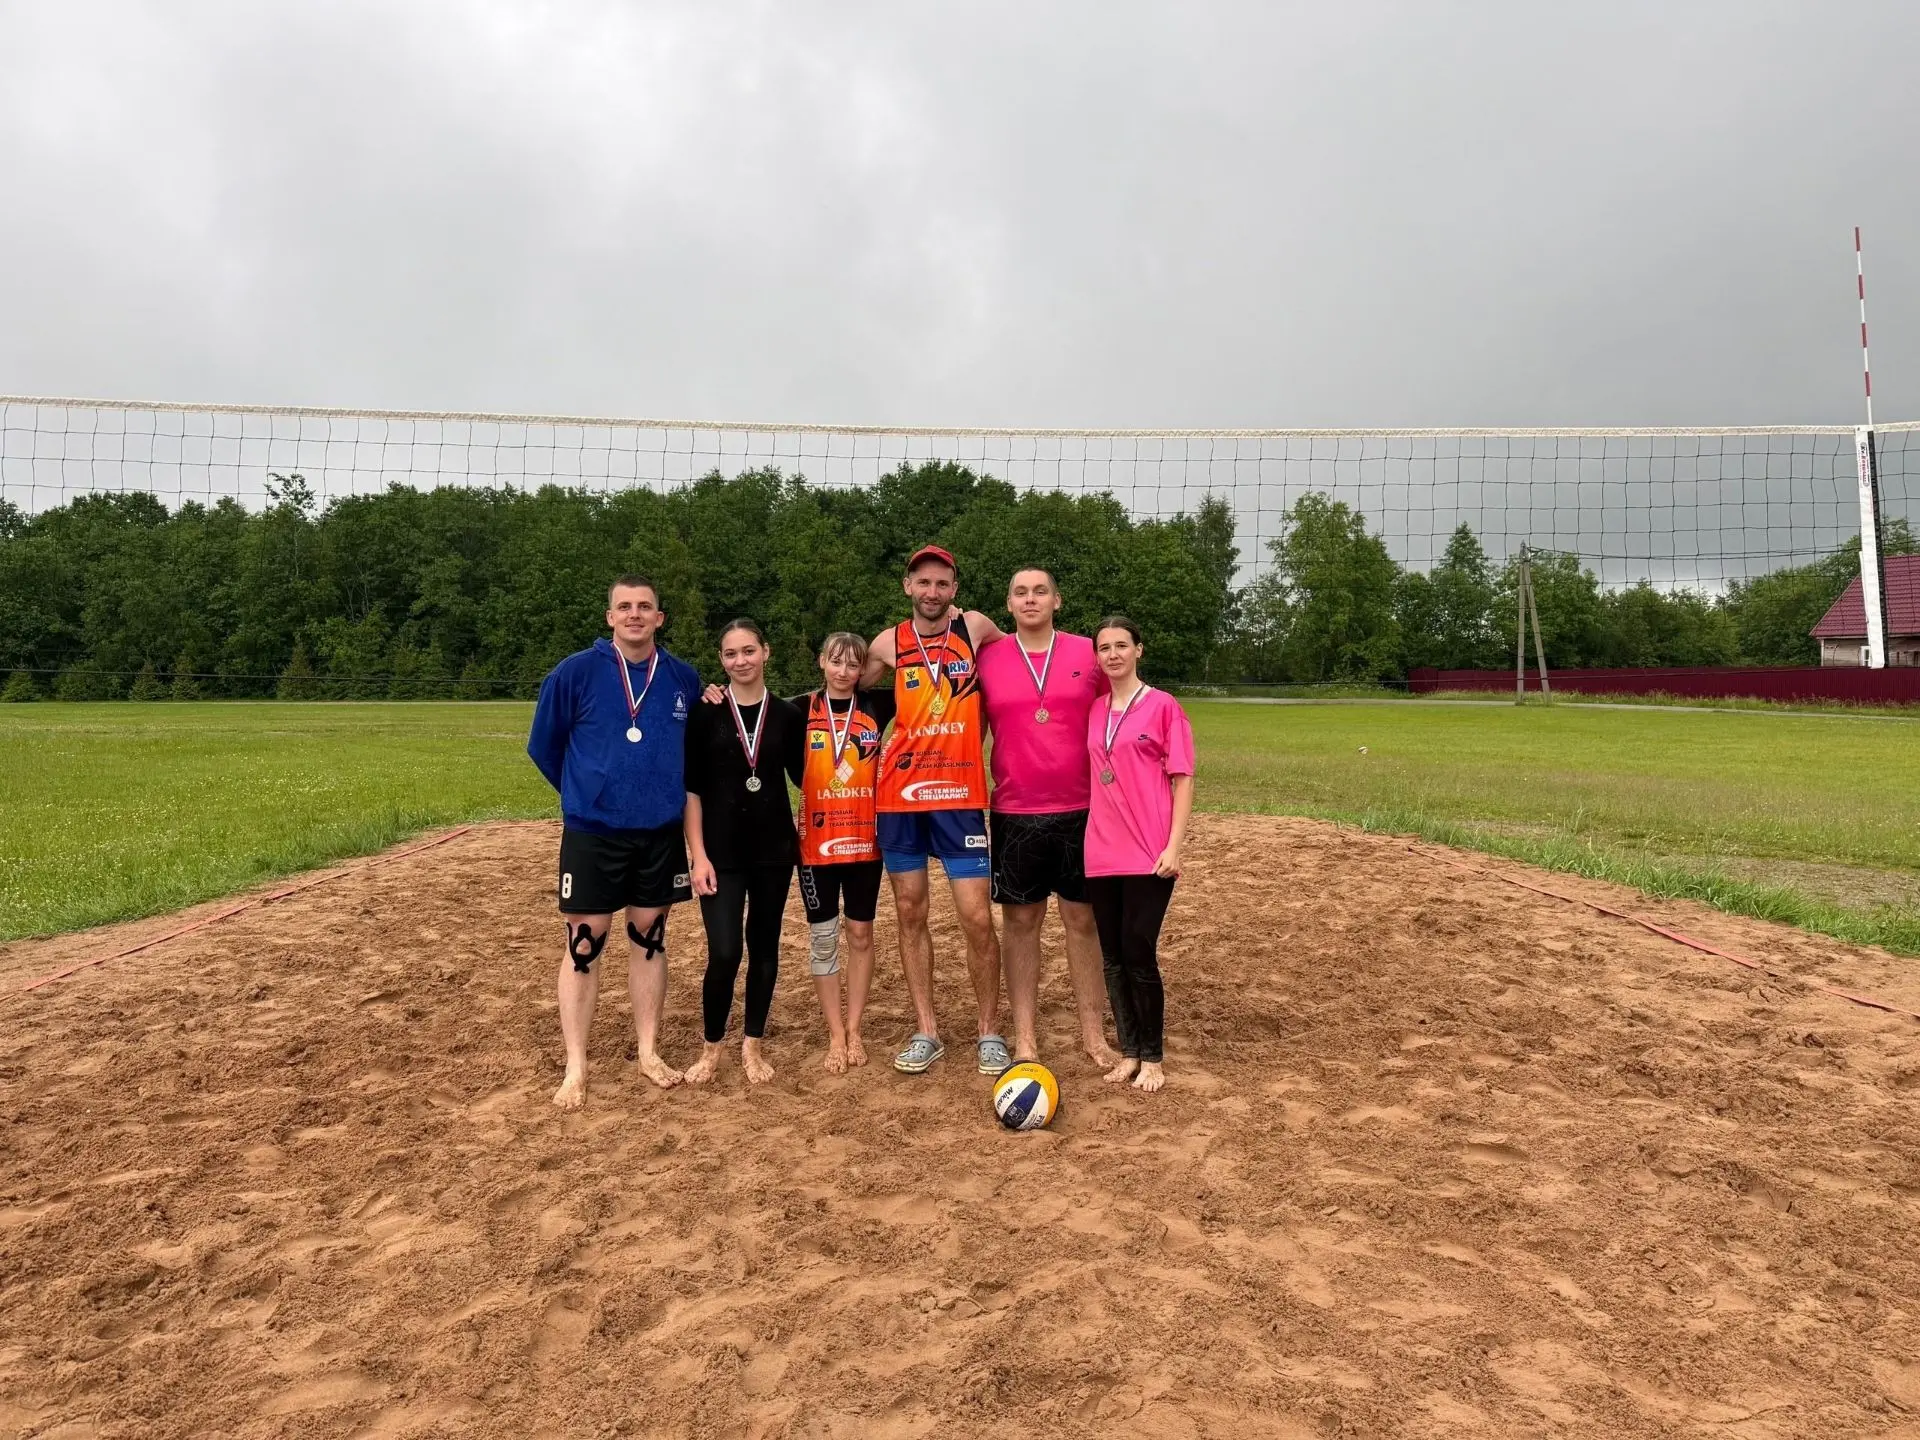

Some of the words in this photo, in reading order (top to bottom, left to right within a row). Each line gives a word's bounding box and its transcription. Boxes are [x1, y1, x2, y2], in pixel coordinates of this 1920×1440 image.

[908, 721, 966, 741] LANDKEY
[914, 762, 933, 770] TEAM
[816, 785, 874, 801] LANDKEY
[918, 784, 969, 795] СИСТЕМНЫЙ
[918, 792, 969, 801] СПЕЦИАЛИСТ
[829, 821, 845, 829] TEAM
[561, 872, 573, 899] 8
